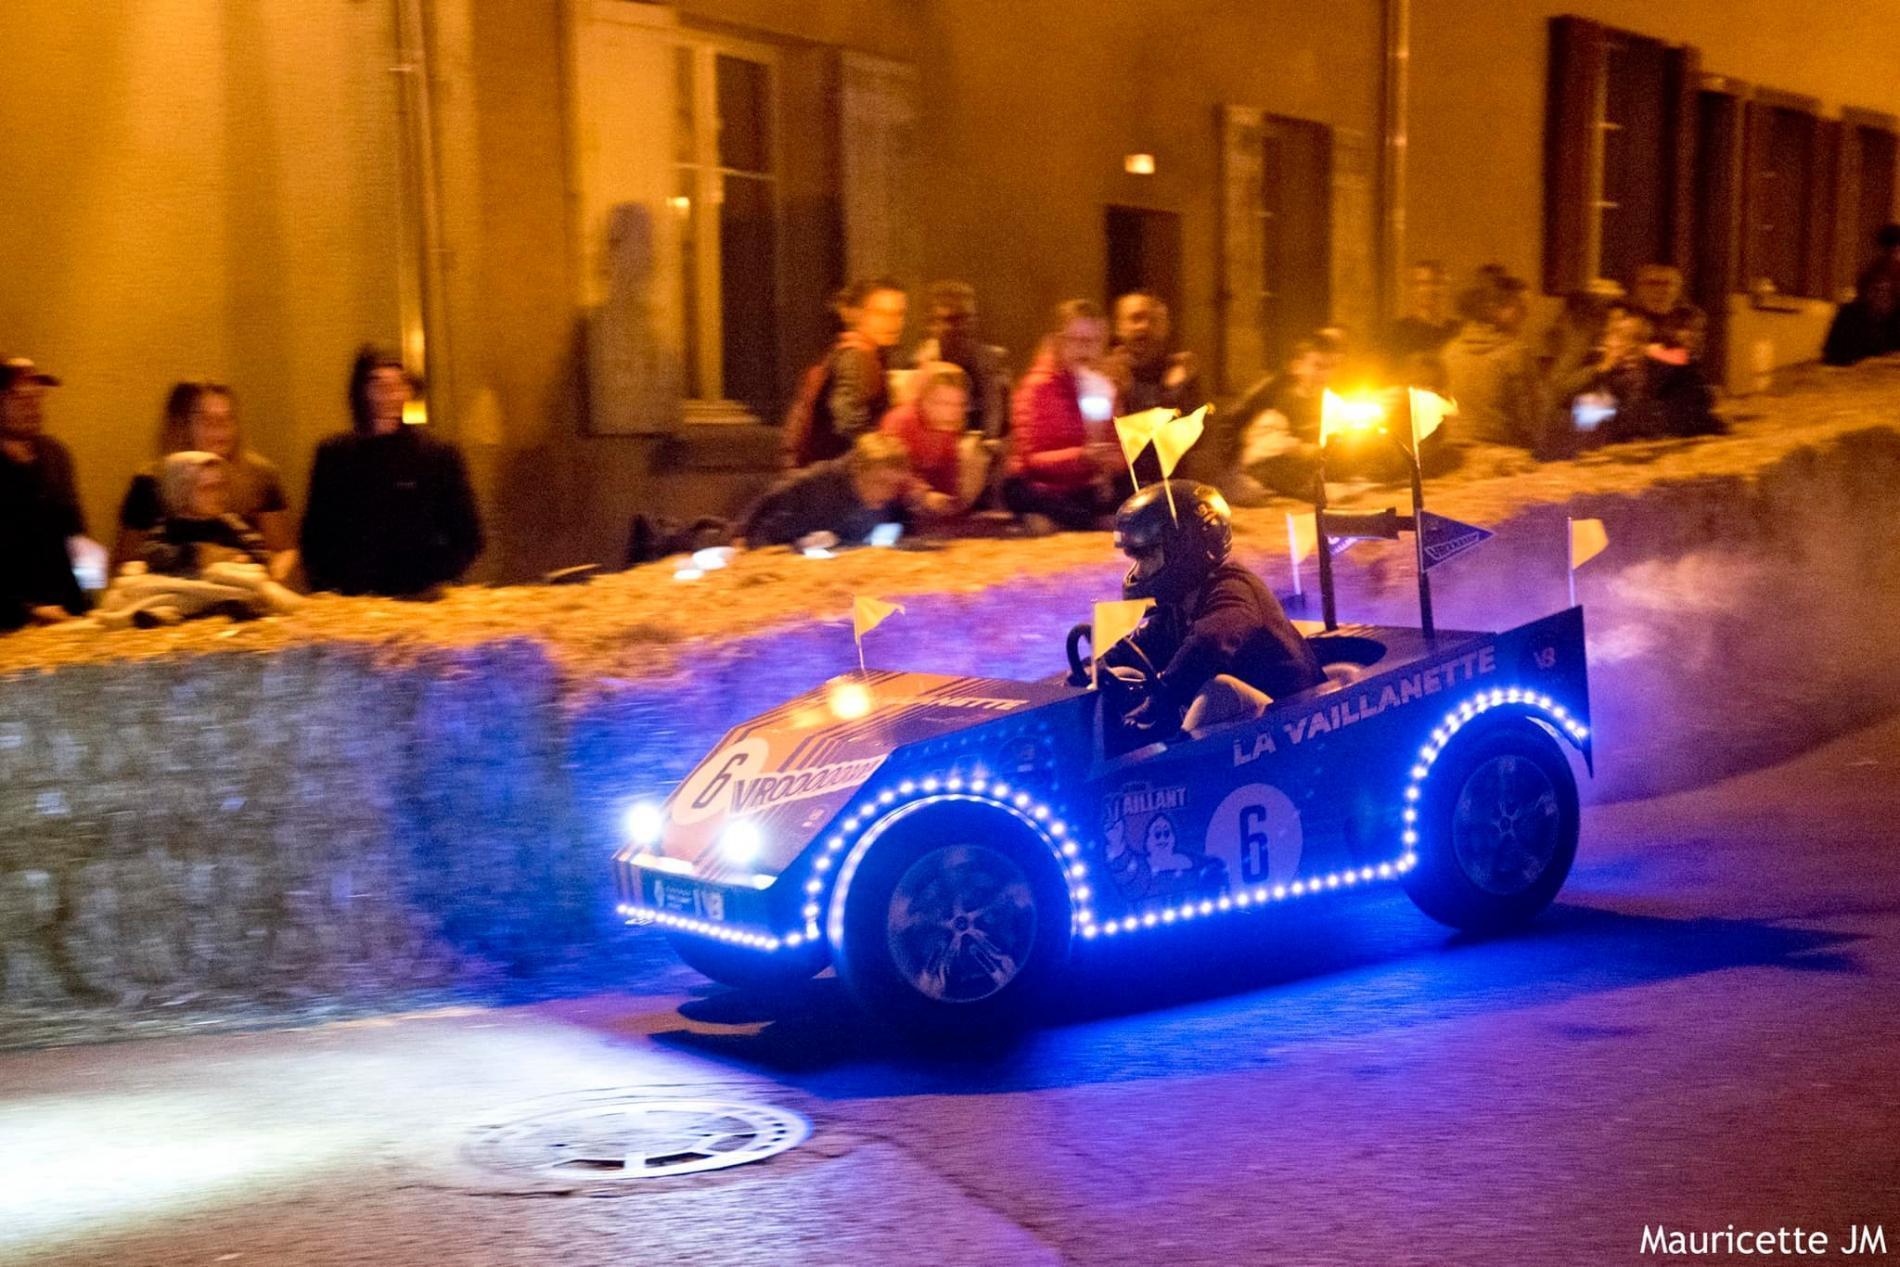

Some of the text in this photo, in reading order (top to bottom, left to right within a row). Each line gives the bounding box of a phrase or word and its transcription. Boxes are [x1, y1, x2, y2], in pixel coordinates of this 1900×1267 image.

[1233, 645, 1497, 767] LA VAILLANETTE
[691, 752, 750, 810] 6
[1239, 804, 1269, 884] 6
